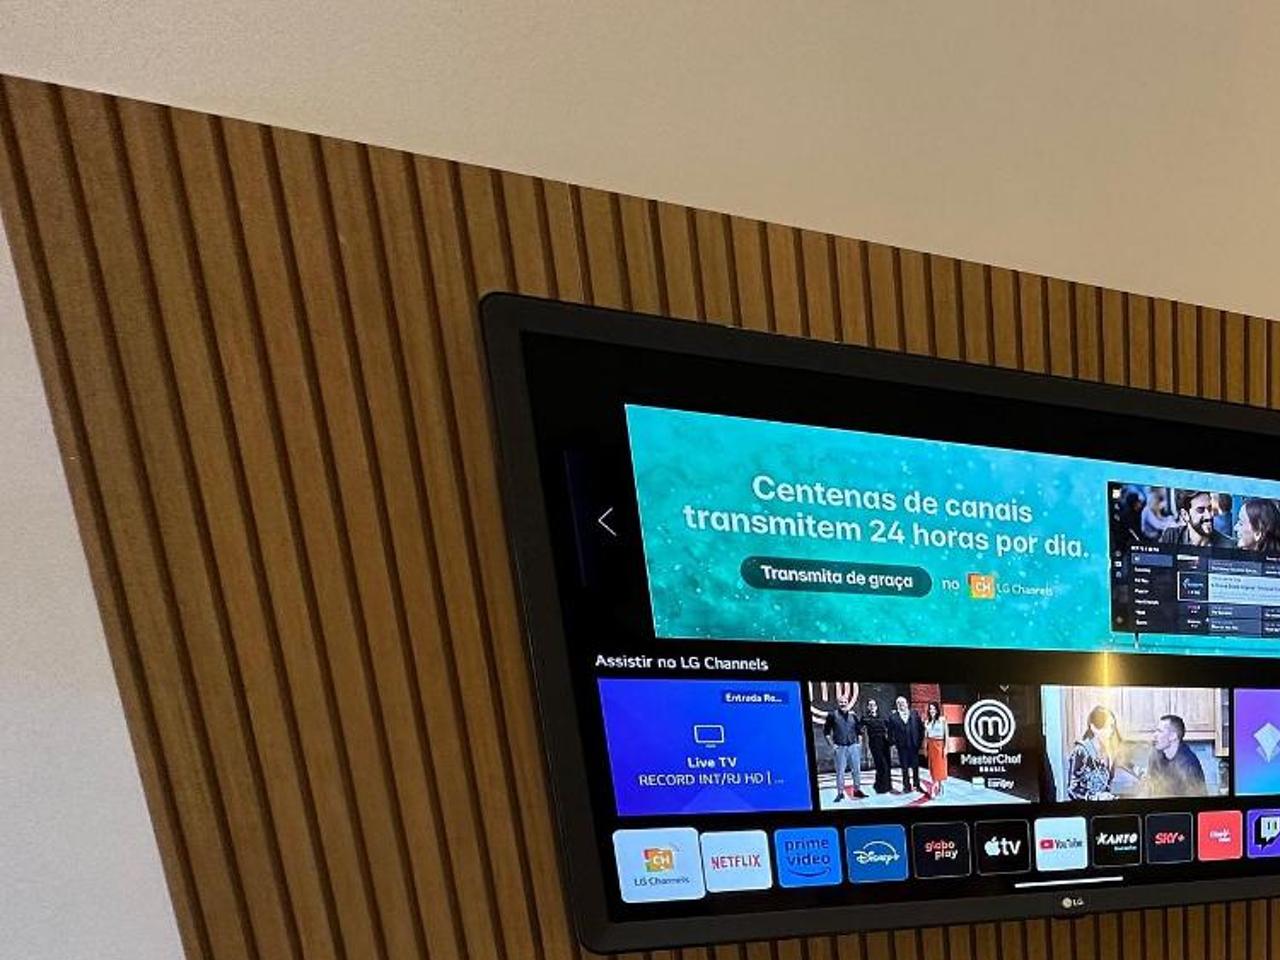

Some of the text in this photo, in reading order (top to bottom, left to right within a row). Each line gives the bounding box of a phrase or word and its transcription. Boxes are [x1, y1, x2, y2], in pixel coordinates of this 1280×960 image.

[752, 475, 1033, 523] Centenas de canais
[682, 504, 1090, 558] transmitem 24 horas por dia.
[760, 564, 914, 591] Transmita de graça
[942, 578, 960, 590] no
[595, 655, 769, 672] Assistir no LG Channels
[725, 692, 762, 703] Entrada
[687, 756, 738, 769] Live TV
[638, 773, 696, 786] RECORD
[699, 773, 742, 785] INT/RJ
[744, 773, 764, 785] HD
[785, 837, 829, 852] prime
[925, 839, 955, 852] globo
[1000, 837, 1021, 856] tv
[787, 853, 831, 866] video
[934, 848, 958, 861] play
[711, 854, 762, 870] NETFLIX
